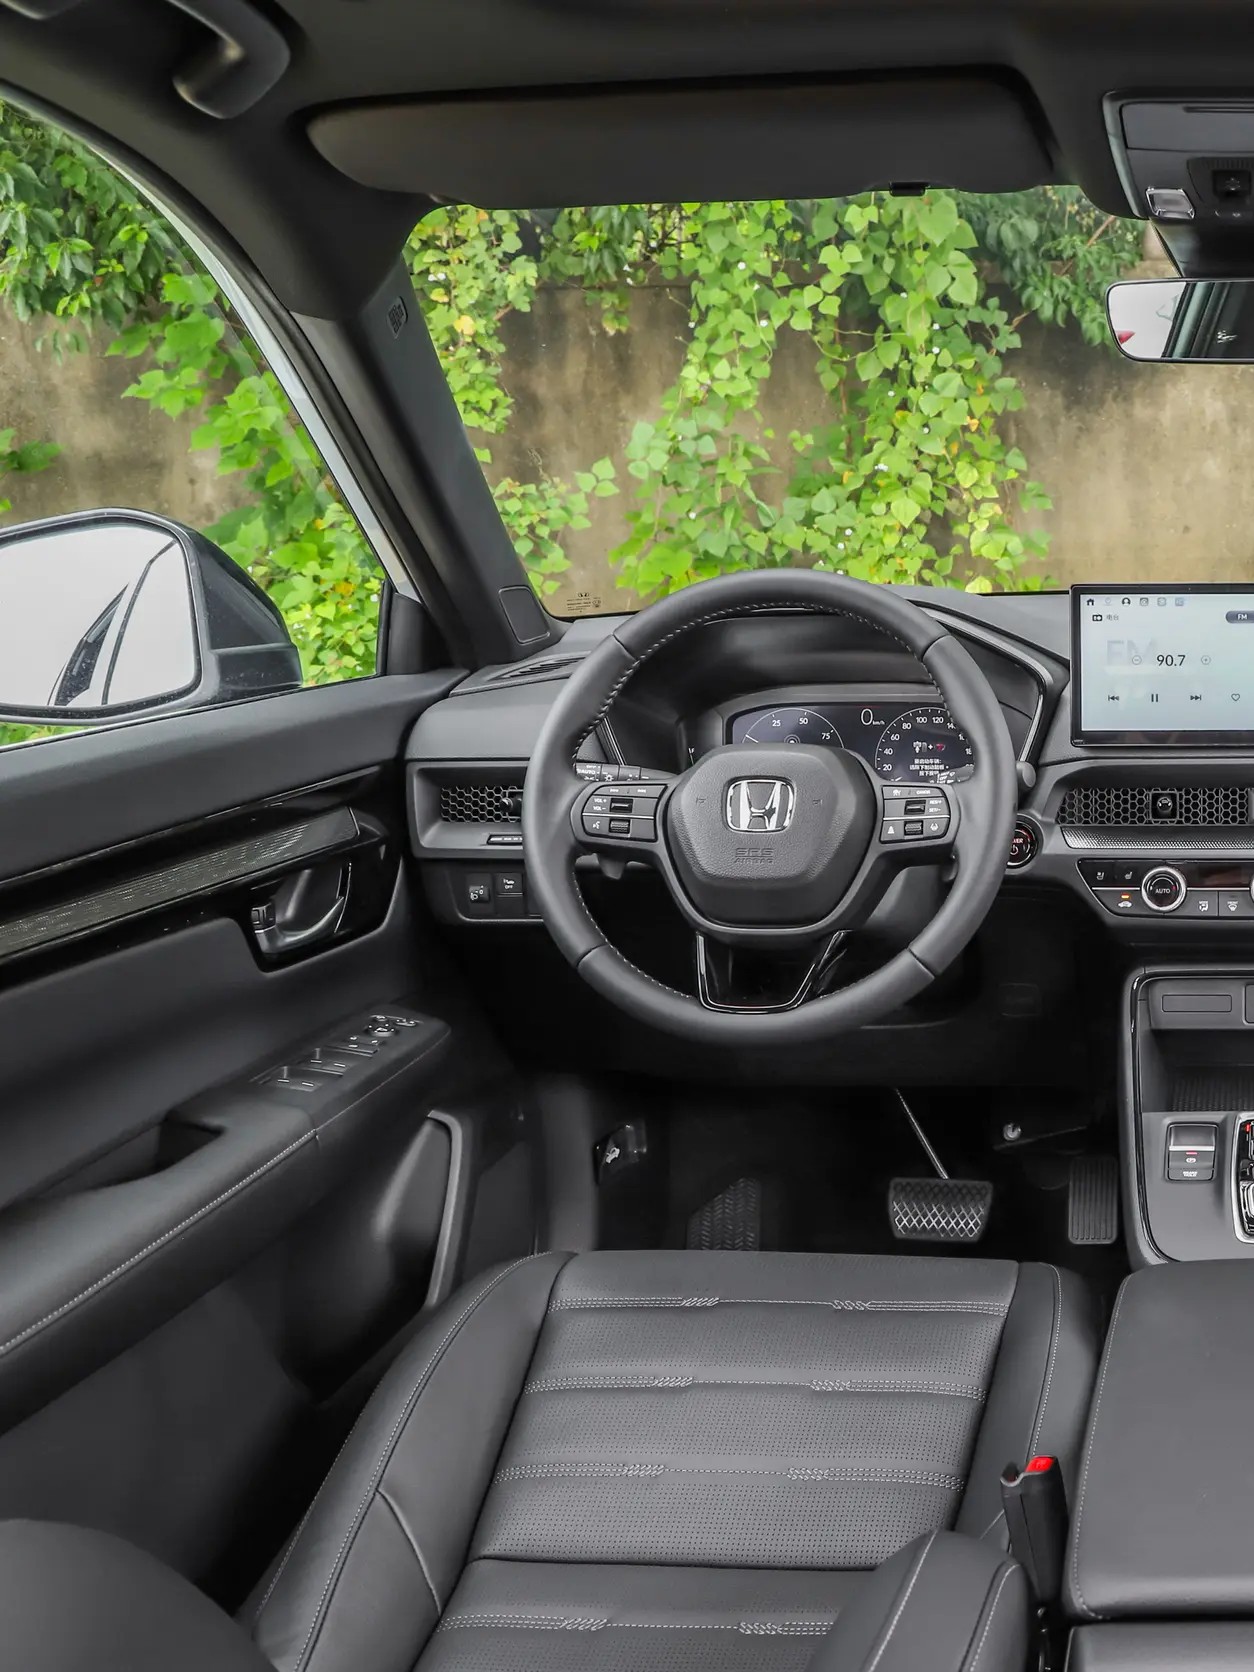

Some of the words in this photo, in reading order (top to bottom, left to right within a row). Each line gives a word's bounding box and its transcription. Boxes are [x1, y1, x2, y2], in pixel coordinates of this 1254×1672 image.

[1237, 613, 1248, 621] FM
[1156, 654, 1187, 668] 90.7
[799, 717, 808, 725] 50
[861, 708, 873, 726] 0
[772, 719, 781, 727] 25
[902, 722, 911, 730] 80
[821, 732, 831, 740] 75
[890, 733, 900, 741] 60
[883, 747, 893, 755] 40
[735, 847, 775, 857] SRS
